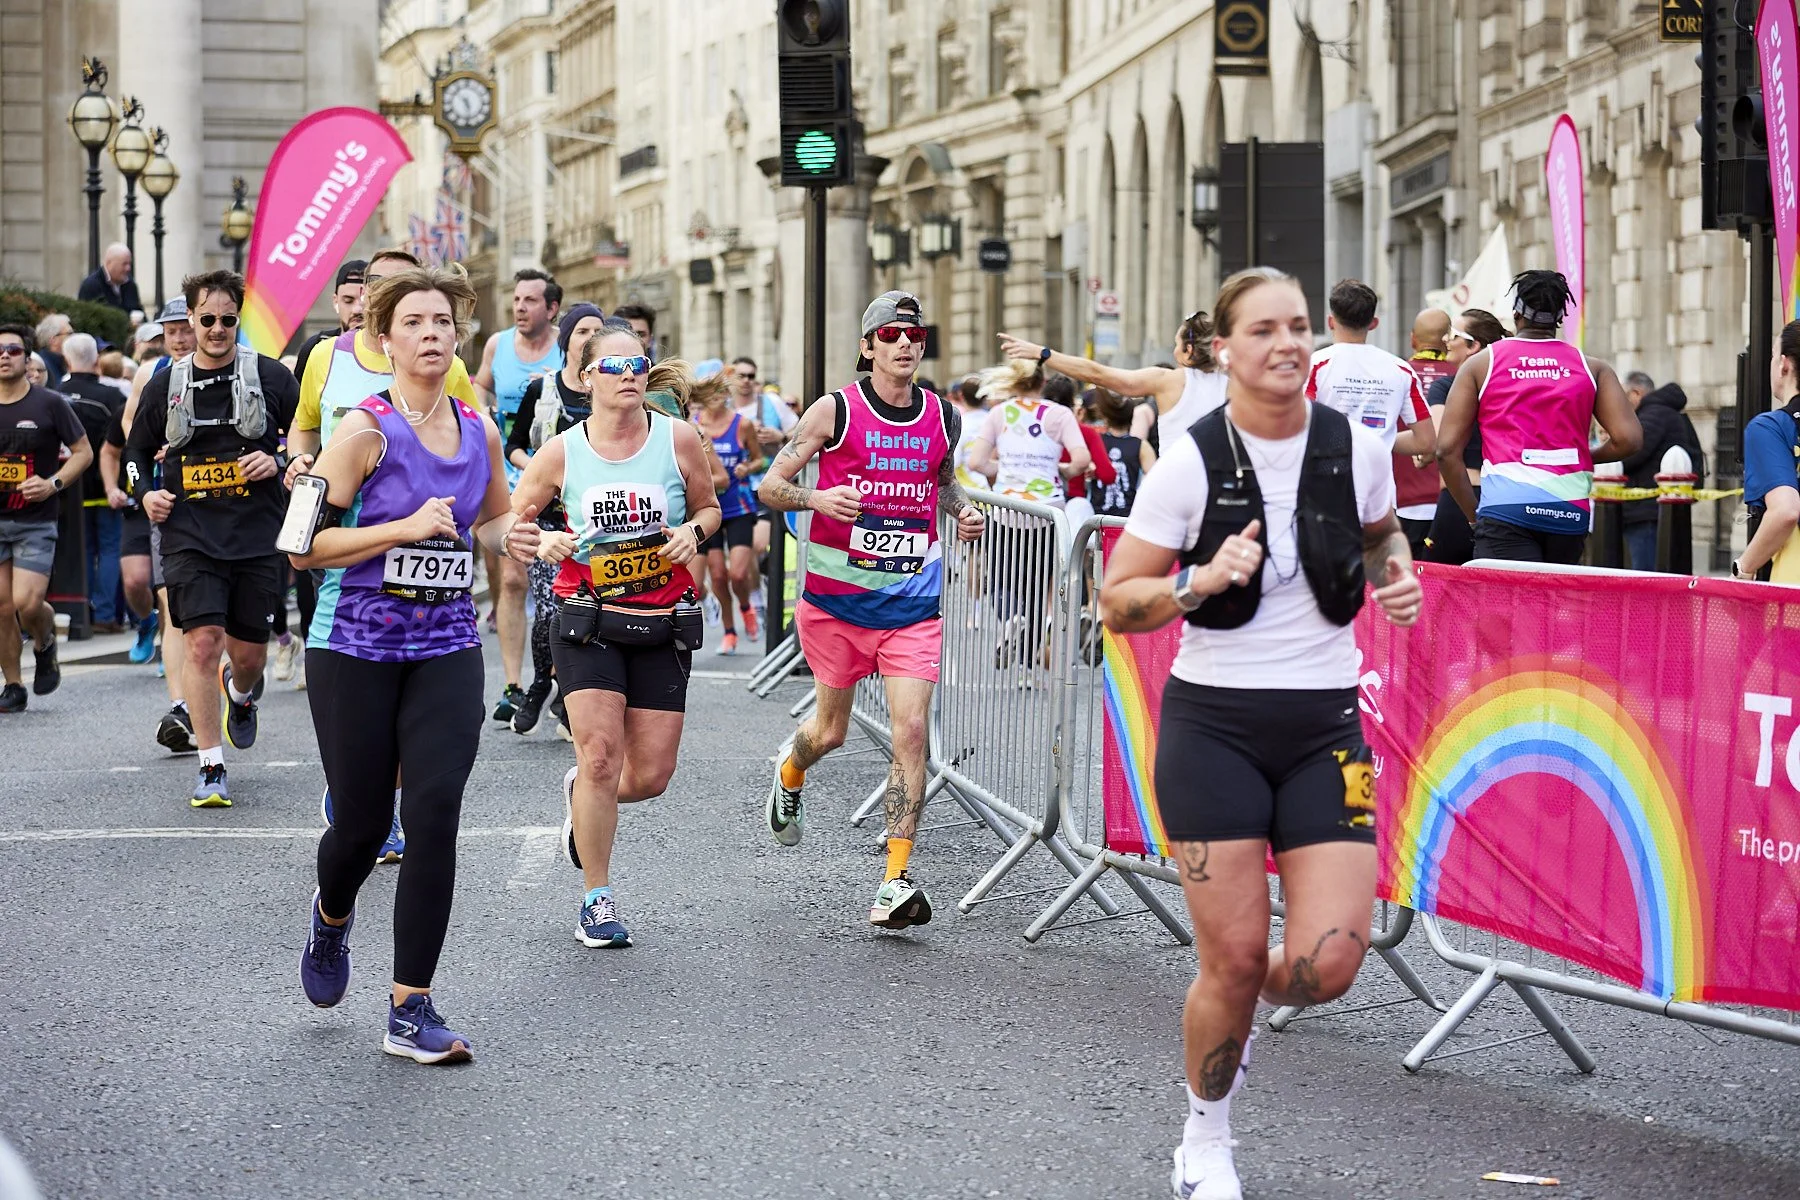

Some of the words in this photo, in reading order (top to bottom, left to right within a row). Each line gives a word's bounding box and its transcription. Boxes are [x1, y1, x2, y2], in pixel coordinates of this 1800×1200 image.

[267, 140, 368, 268] Tommy's
[1518, 356, 1558, 367] Team
[1508, 366, 1571, 380] Tommy's
[865, 430, 931, 454] Harley
[865, 452, 928, 472] James
[0, 466, 18, 479] 29
[191, 465, 236, 484] 4434
[606, 490, 625, 499] THE
[847, 473, 933, 502] Tommy's
[592, 492, 652, 514] BRAIN
[860, 502, 886, 511] gether,
[888, 502, 899, 510] for
[901, 505, 920, 513] every
[591, 511, 662, 528] TUMOUR
[1525, 505, 1581, 521] tommys.org
[883, 519, 905, 527] DAVID
[414, 540, 454, 548] CHRISTINE
[617, 541, 637, 551] TASH
[862, 531, 914, 554] 9271
[393, 554, 467, 581] 17974
[603, 551, 661, 579] 3678
[1738, 827, 1774, 859] The
